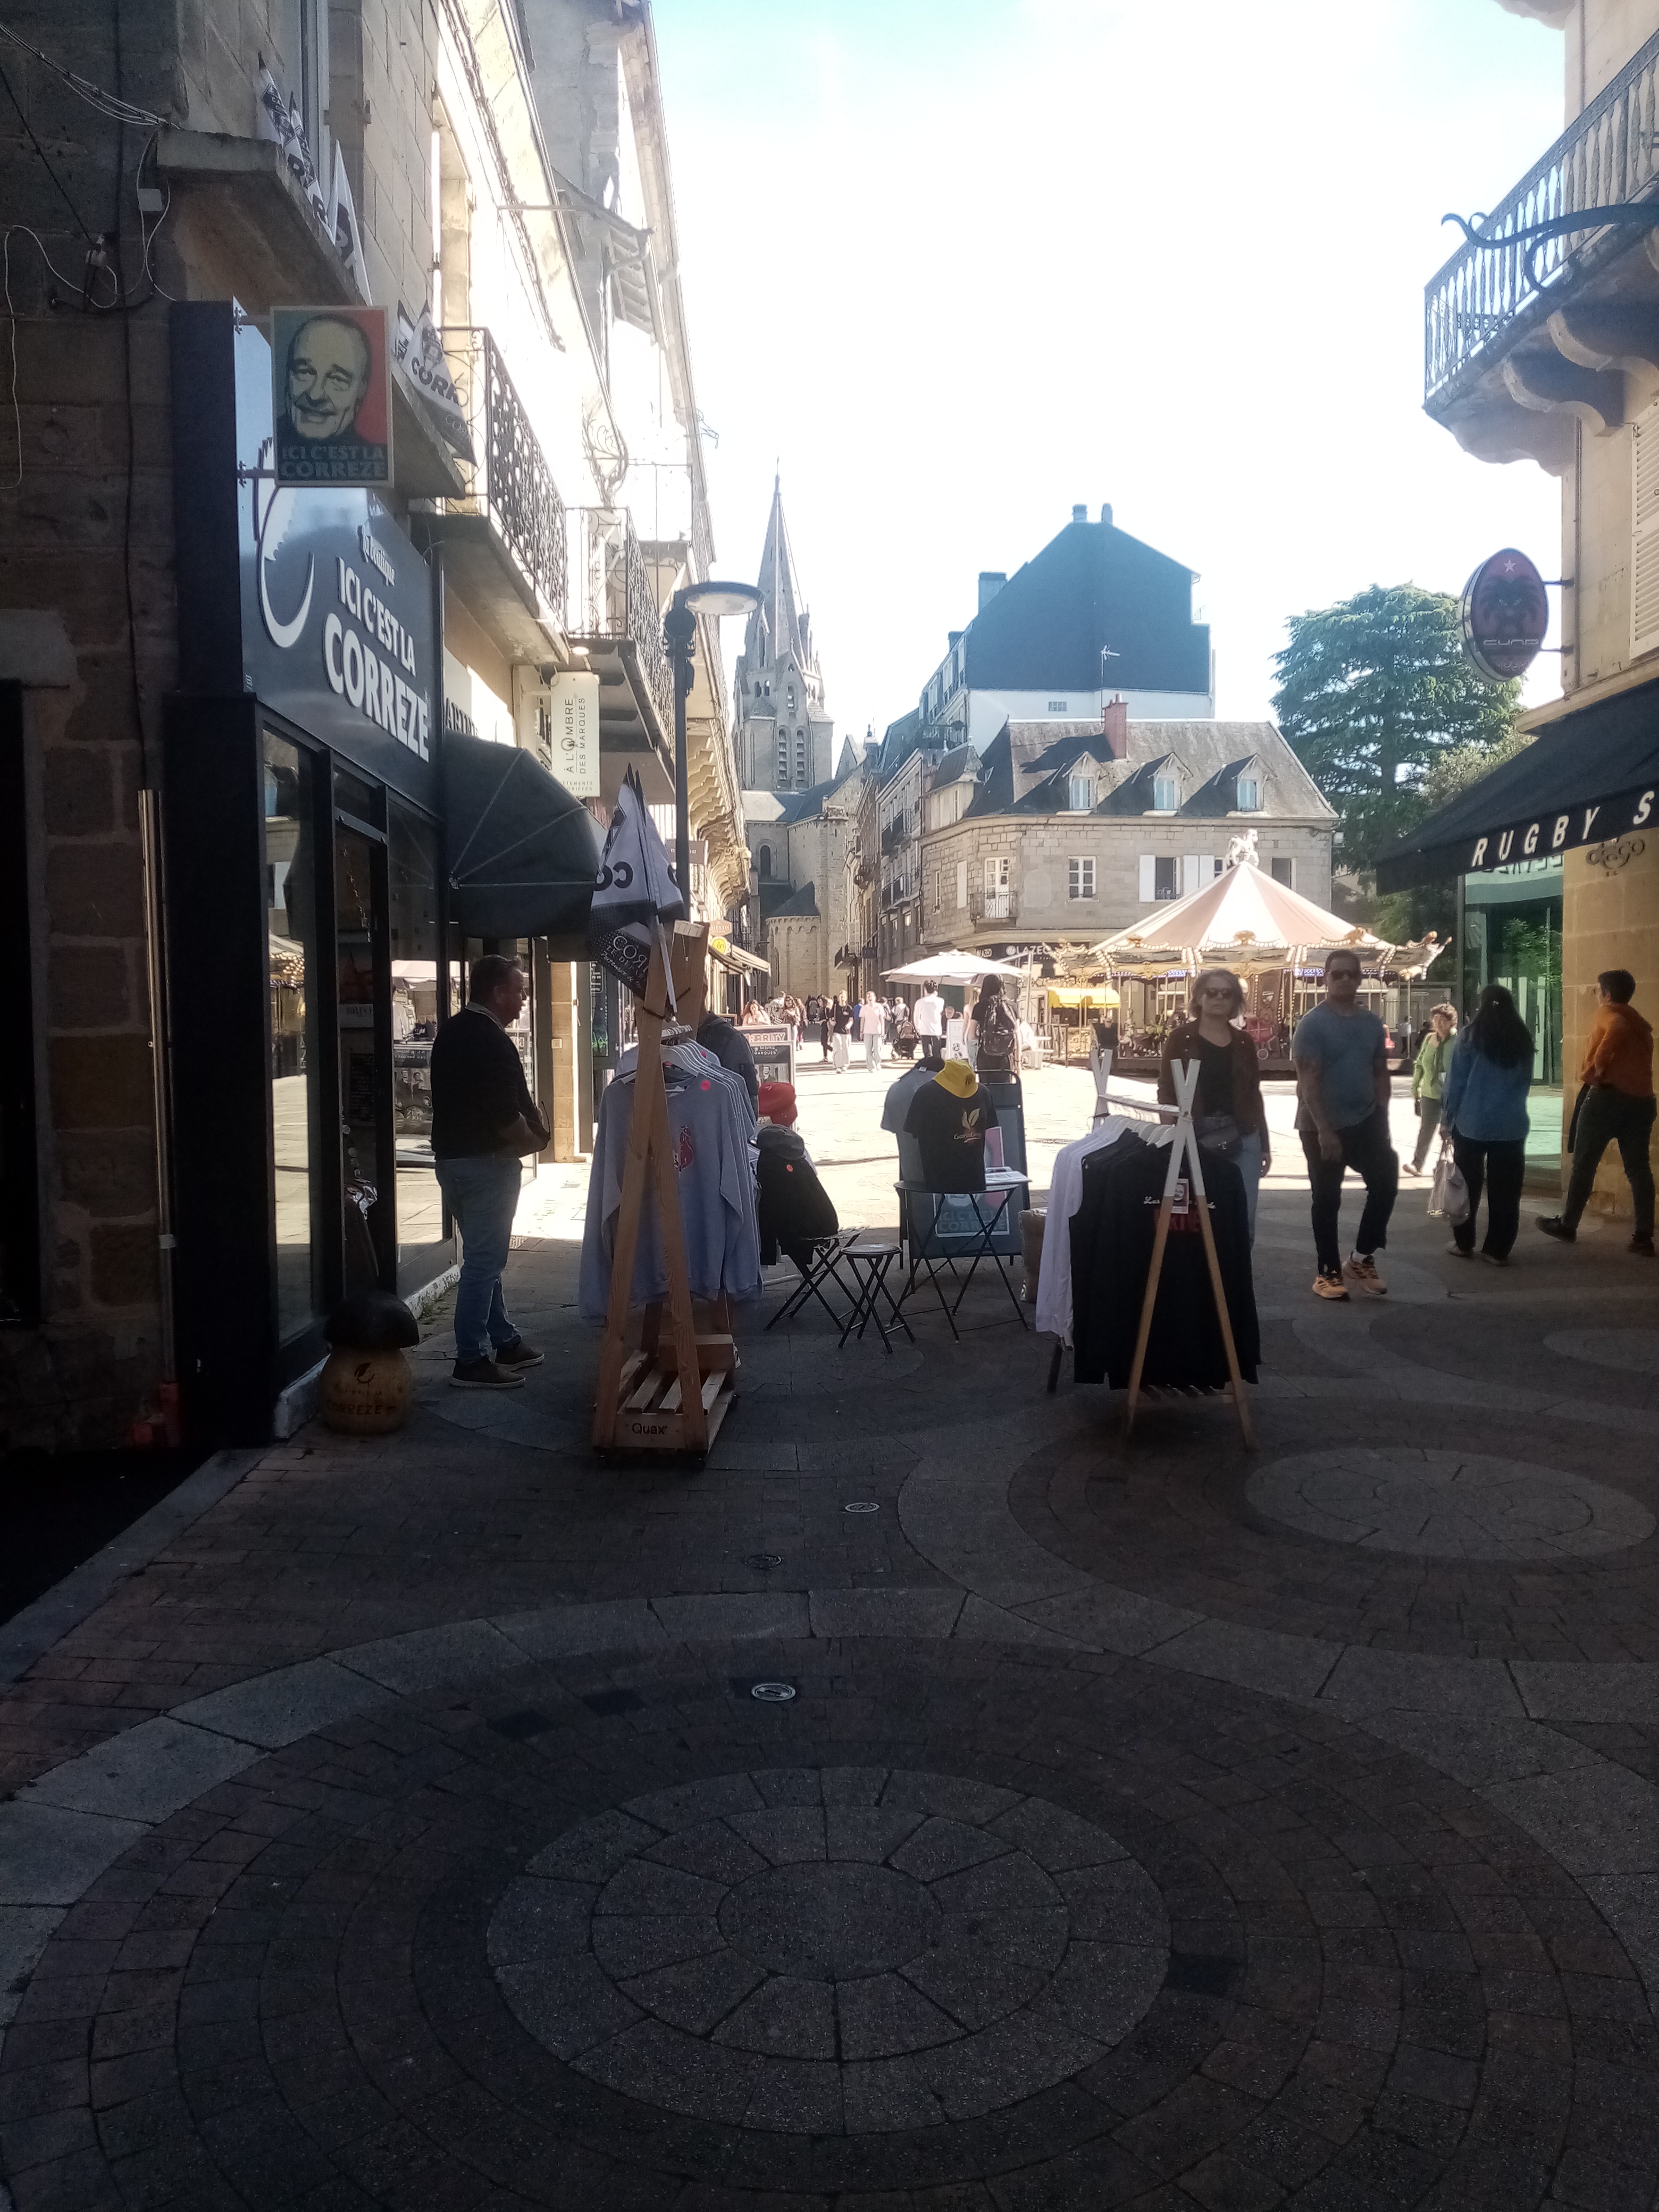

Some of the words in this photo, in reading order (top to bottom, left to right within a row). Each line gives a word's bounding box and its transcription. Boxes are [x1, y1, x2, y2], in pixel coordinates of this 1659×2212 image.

[279, 460, 386, 477] CORREZE
[282, 446, 306, 458] ICI
[362, 446, 383, 458] LA
[337, 556, 362, 621] ICI
[363, 586, 400, 658] C'EST
[400, 625, 416, 678] LA
[324, 611, 430, 763] CORREZE
[1471, 806, 1601, 868] RUGBY
